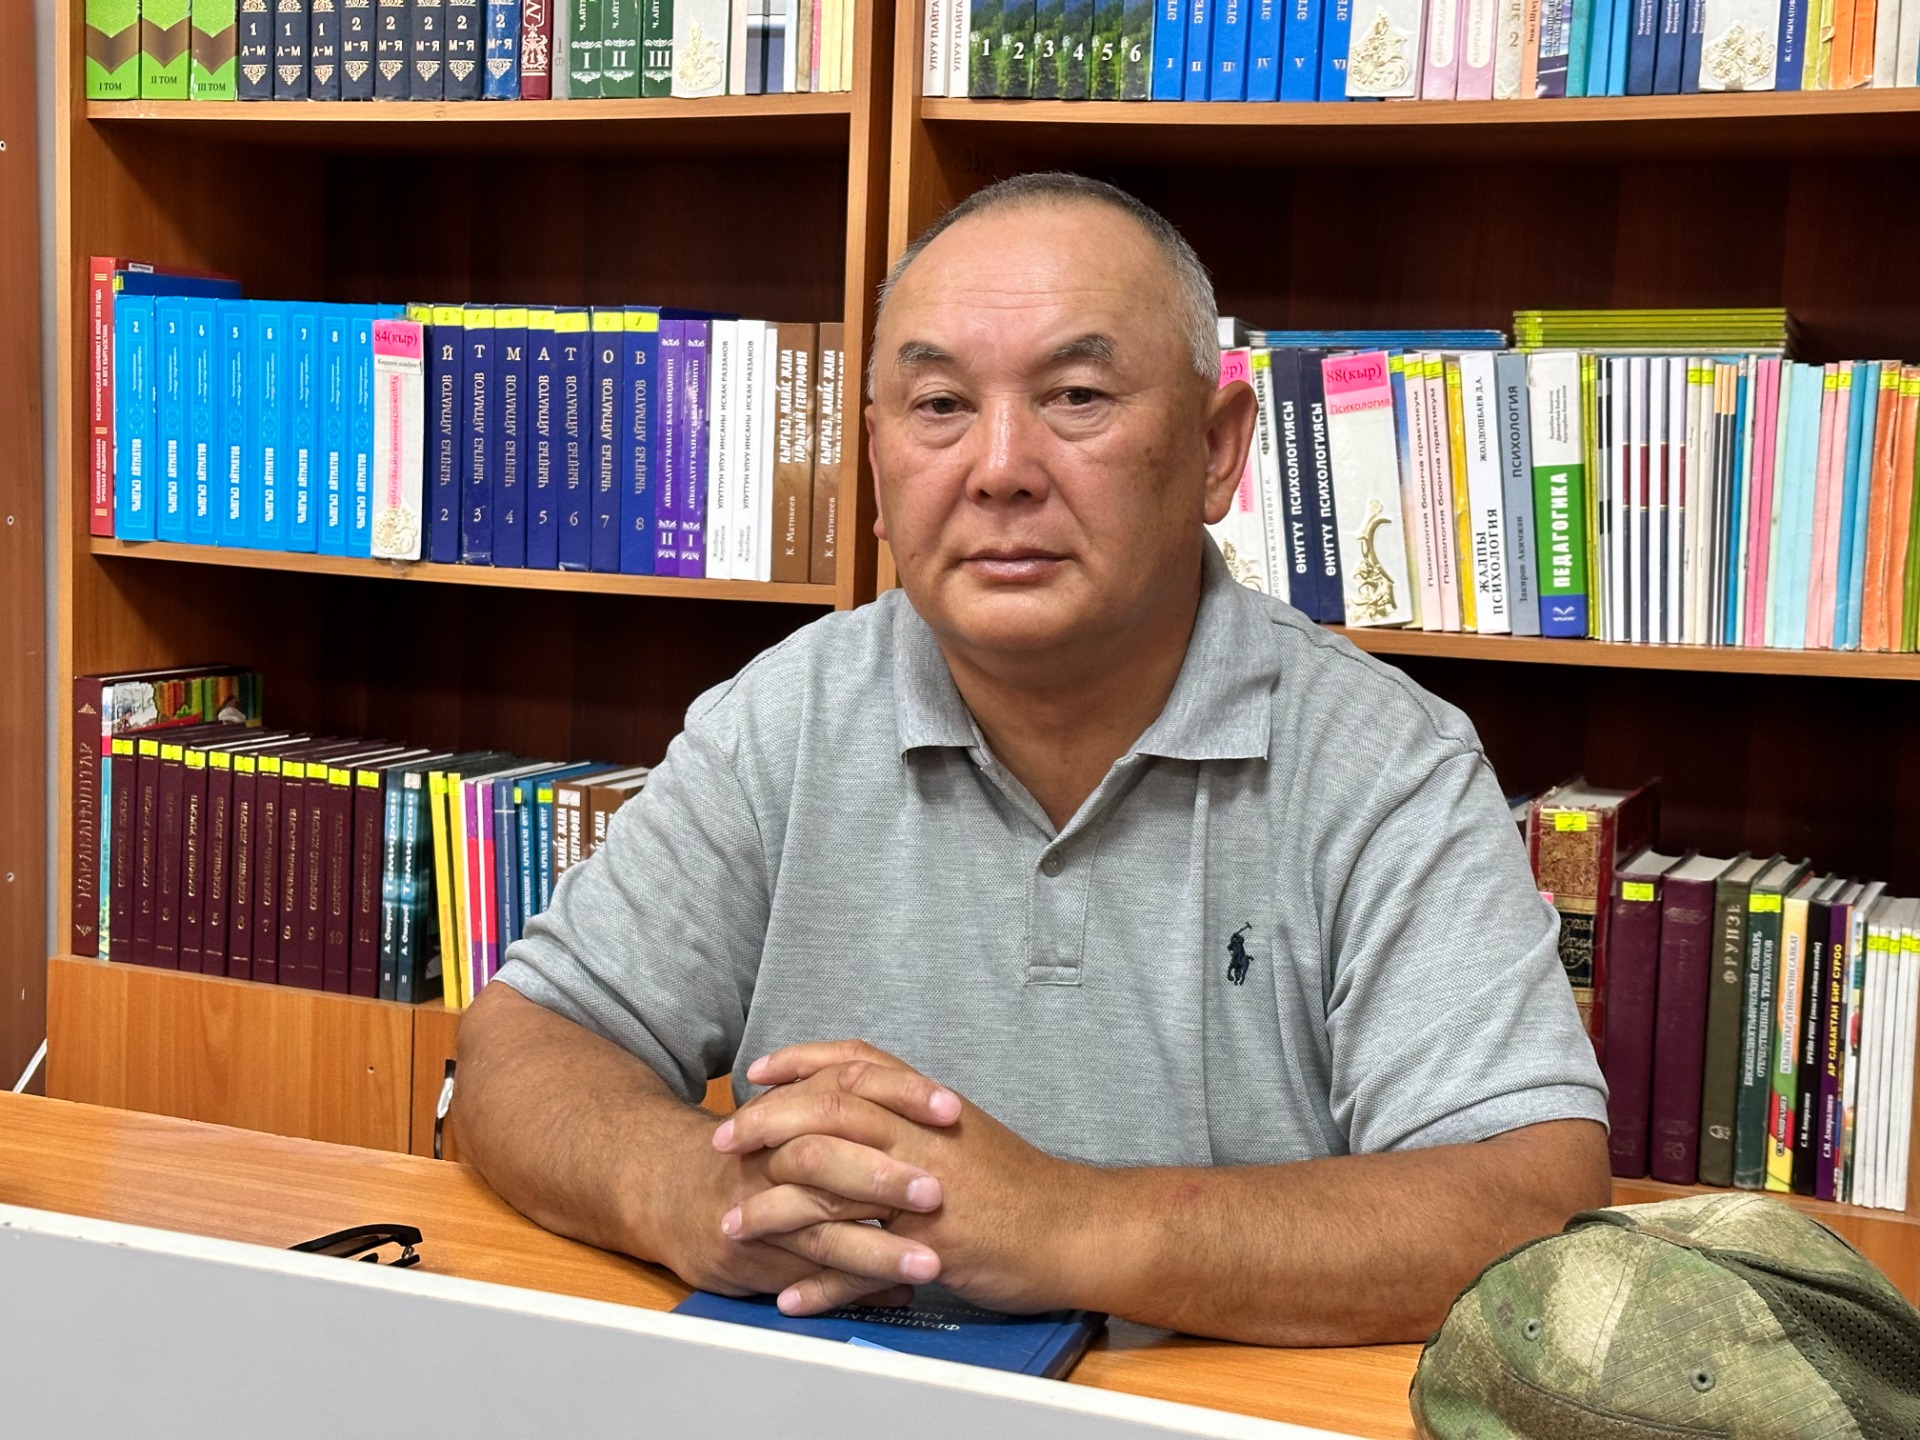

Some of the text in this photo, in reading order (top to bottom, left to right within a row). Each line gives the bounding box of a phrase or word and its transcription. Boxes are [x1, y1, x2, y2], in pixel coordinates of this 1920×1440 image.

[250, 23, 257, 36] 1
[284, 23, 292, 36] 1
[318, 23, 325, 36] 1
[351, 16, 362, 31] 2
[386, 16, 396, 31] 2
[423, 16, 433, 31] 2
[457, 15, 468, 30] 2
[495, 15, 506, 29] 2
[344, 39, 369, 52] М-Я
[378, 39, 403, 52] М-Я
[416, 39, 440, 52] М-Я
[448, 38, 475, 52] М-Я
[487, 38, 512, 51] М-Я
[981, 39, 991, 56] 1
[1042, 39, 1055, 58] 3
[1508, 31, 1519, 48] 2
[241, 44, 266, 57] А-М
[276, 45, 301, 57] А-М
[312, 44, 334, 57] А-М
[584, 51, 590, 69] I
[612, 50, 627, 67] II
[648, 50, 671, 67] III
[929, 41, 938, 72] УЛУУ
[953, 42, 962, 72] УЛУУ
[1012, 42, 1025, 60] 2
[1072, 43, 1084, 61] 4
[1101, 43, 1114, 61] 5
[1129, 44, 1142, 63] 6
[104, 82, 122, 91] ТОМ
[160, 75, 178, 85] ТОМ
[208, 82, 226, 92] ТОМ
[132, 320, 140, 333] 2
[168, 321, 175, 334] 3
[198, 324, 205, 337] 4
[232, 326, 239, 339] 5
[266, 327, 273, 340] 6
[300, 327, 307, 340] 7
[331, 330, 338, 343] 8
[360, 331, 366, 344] 9
[442, 343, 646, 365] Й Т М А Т О В
[780, 349, 793, 379] ЖАНА
[821, 349, 835, 380] ЖАНА
[1326, 363, 1382, 384] 88(кыр)
[793, 350, 808, 464] ТАРЫХЫЙ ГЕОГРАФИЯ
[1330, 398, 1391, 415] Психология
[440, 374, 453, 486] ЧЫҢГЫЗ АЙТМАТОВ
[473, 372, 485, 484] ЧЫҢГЫЗ АЙТМАТОВ
[504, 374, 516, 487] ЧЫҢГЫЗ АЙТМАТОВ
[537, 374, 550, 488] ЧЫҢГЫЗ АЙТМАТОВ
[565, 375, 579, 489] ЧЫҢГЫЗ АЙТМАТОВ
[600, 377, 613, 492] ЧЫҢГЫЗ АЙТМАТОВ
[717, 340, 729, 509] УЛУТТУН УЛУУ ИНСАНЫ ИСХАК РАЗЗАКОВ
[742, 340, 754, 509] УЛУТТУН УЛУУ ИНСАНЫ ИСХАК РАЗЗАКОВ
[1475, 394, 1488, 462] ЖОЛДОШБАЕВ
[1507, 385, 1522, 478] ПСИХОЛОГИЯ
[633, 379, 647, 494] ЧЫҢГЫЗ АЙТМАТОВ
[130, 438, 142, 477] АЙТМАТОВ
[167, 439, 178, 478] АЙТМАТОВ
[196, 443, 207, 482] АЙТМАТОВ
[229, 445, 240, 484] АЙТМАТОВ
[263, 447, 274, 486] АЙТМАТОВ
[297, 448, 308, 488] АЙТМАТОВ
[328, 451, 339, 491] АЙТМАТОВ
[356, 452, 367, 493] АЙТМАТОВ
[1282, 400, 1307, 574] ӨНҮГҮҮ ПСИХОЛОГИЯСЫ
[1311, 402, 1336, 576] ӨНҮГҮҮ ПСИХОЛОГИЯСЫ
[1412, 390, 1434, 587] Психология боюнча практикум
[1428, 387, 1450, 584] Психология боюнча практикум
[441, 508, 449, 522] 2
[474, 507, 482, 522] 3
[505, 509, 514, 524] 4
[539, 510, 548, 524] 5
[569, 511, 579, 526] 6
[601, 514, 609, 528] 7
[636, 517, 644, 530] 8
[786, 495, 796, 556] К. Матикеев
[824, 497, 835, 557] К. Матикеев
[1550, 472, 1572, 588] ПЕДАГОГИКА
[1475, 531, 1490, 594] ЖАЛПЫ
[1486, 507, 1503, 615] ПСИХОЛОГИЯ
[1515, 516, 1529, 603] Закиров Акимжан
[557, 807, 568, 836] ЖАНА
[594, 810, 606, 839] ЖАНА
[385, 791, 398, 894] Темирлан
[403, 793, 415, 895] Темирлан
[569, 809, 581, 864] ГЕОГРАФИЯ
[1722, 903, 1741, 985] ФРУНЗЕ
[1751, 930, 1762, 971] СЛОВАРЬ
[1787, 934, 1798, 968] САЯКАТ
[1757, 939, 1773, 1078] ОТЕЧЕСТВЕННЫХ ТЮРКОЛОГОВ
[1827, 943, 1842, 1077] АР САБАКТАН БИР СУРОО
[864, 1314, 960, 1331] ФРАНЦУЗ
